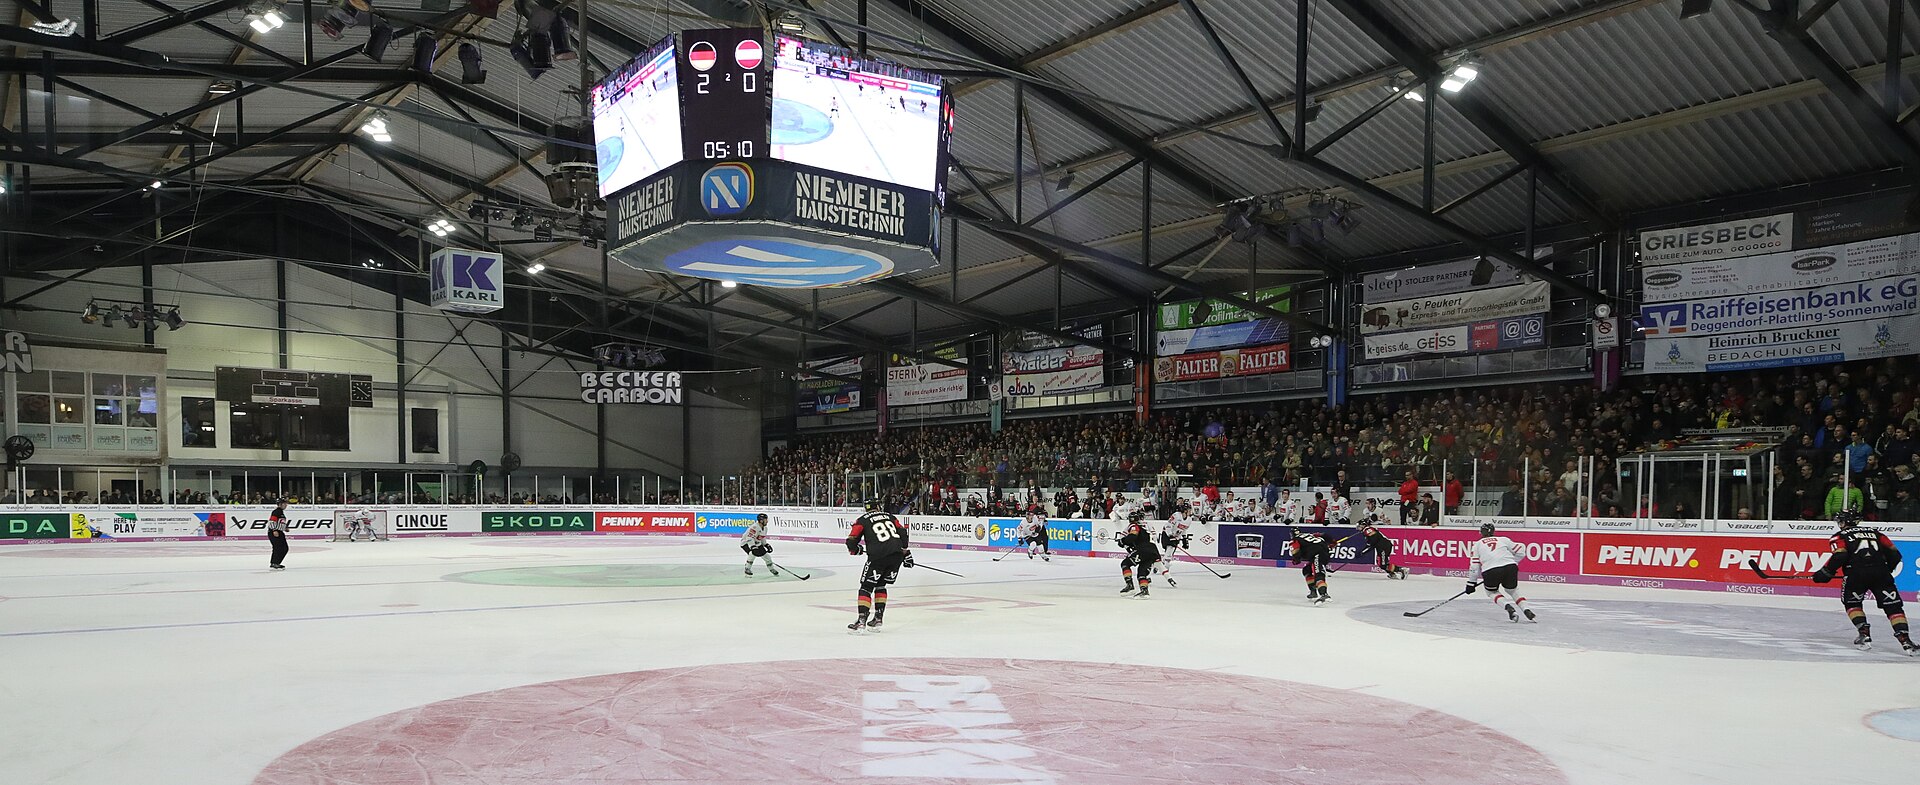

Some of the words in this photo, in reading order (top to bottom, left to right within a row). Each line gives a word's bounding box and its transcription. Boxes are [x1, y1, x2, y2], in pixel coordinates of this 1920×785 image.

[697, 74, 709, 94] 2
[725, 73, 731, 82] 2
[743, 72, 756, 92] 0
[618, 175, 674, 222] NIEMEIER
[796, 171, 905, 217] NIEMEIER
[618, 200, 674, 240] HAUSTECHNIK
[796, 197, 905, 236] HAUSTECHNIK
[1645, 221, 1781, 252] GRIESBECK
[1660, 252, 1680, 260] LIEBE
[1682, 250, 1699, 258] ZUM
[1797, 258, 1830, 268] IsarPark
[1368, 278, 1402, 293] sleep
[1405, 275, 1435, 286] STOLZER
[1436, 271, 1467, 281] PARTNER
[1747, 276, 1839, 291] Rehabilitation
[432, 290, 447, 302] KARL
[453, 290, 499, 302] KARL
[1692, 283, 1872, 320] Raiffeisenbank
[1880, 278, 1918, 299] eG
[1411, 302, 1421, 311] G.
[1424, 297, 1462, 310] Peukert
[1411, 311, 1440, 320] Express-
[1441, 308, 1455, 316] und
[1457, 299, 1517, 314] Transportlogistik
[1520, 295, 1545, 306] GmbH
[1691, 298, 1917, 334] Deggendorf-Plattling-Sonnenwald
[1474, 323, 1496, 331] PARTNER
[1083, 330, 1103, 340] PARTNER
[1709, 332, 1767, 348] Heinrich
[1772, 328, 1840, 343] Bruckner
[1367, 341, 1409, 356] k-geiss.de
[1707, 343, 1842, 361] BEDACHUNGEN
[1019, 354, 1067, 371] haider
[1176, 357, 1219, 376] FALTER
[1239, 349, 1287, 371] FALTER
[581, 372, 681, 388] BECKER
[888, 368, 917, 380] STERN
[269, 396, 303, 404] Sparkasse
[581, 388, 682, 404] CARBON
[249, 519, 334, 530] BUER
[395, 514, 448, 528] CINQUE
[491, 516, 585, 528] ŠKODA
[773, 516, 819, 529] WESTMINSTER
[910, 522, 920, 531] NO
[922, 523, 934, 532] REF
[940, 523, 951, 532] NO
[951, 523, 972, 533] GAME
[113, 523, 136, 534] PLAY
[1487, 542, 1497, 552] 7
[1528, 574, 1567, 583] MEGATECH
[1621, 579, 1664, 588] MEGATECH
[1726, 585, 1775, 594] MEGATECH
